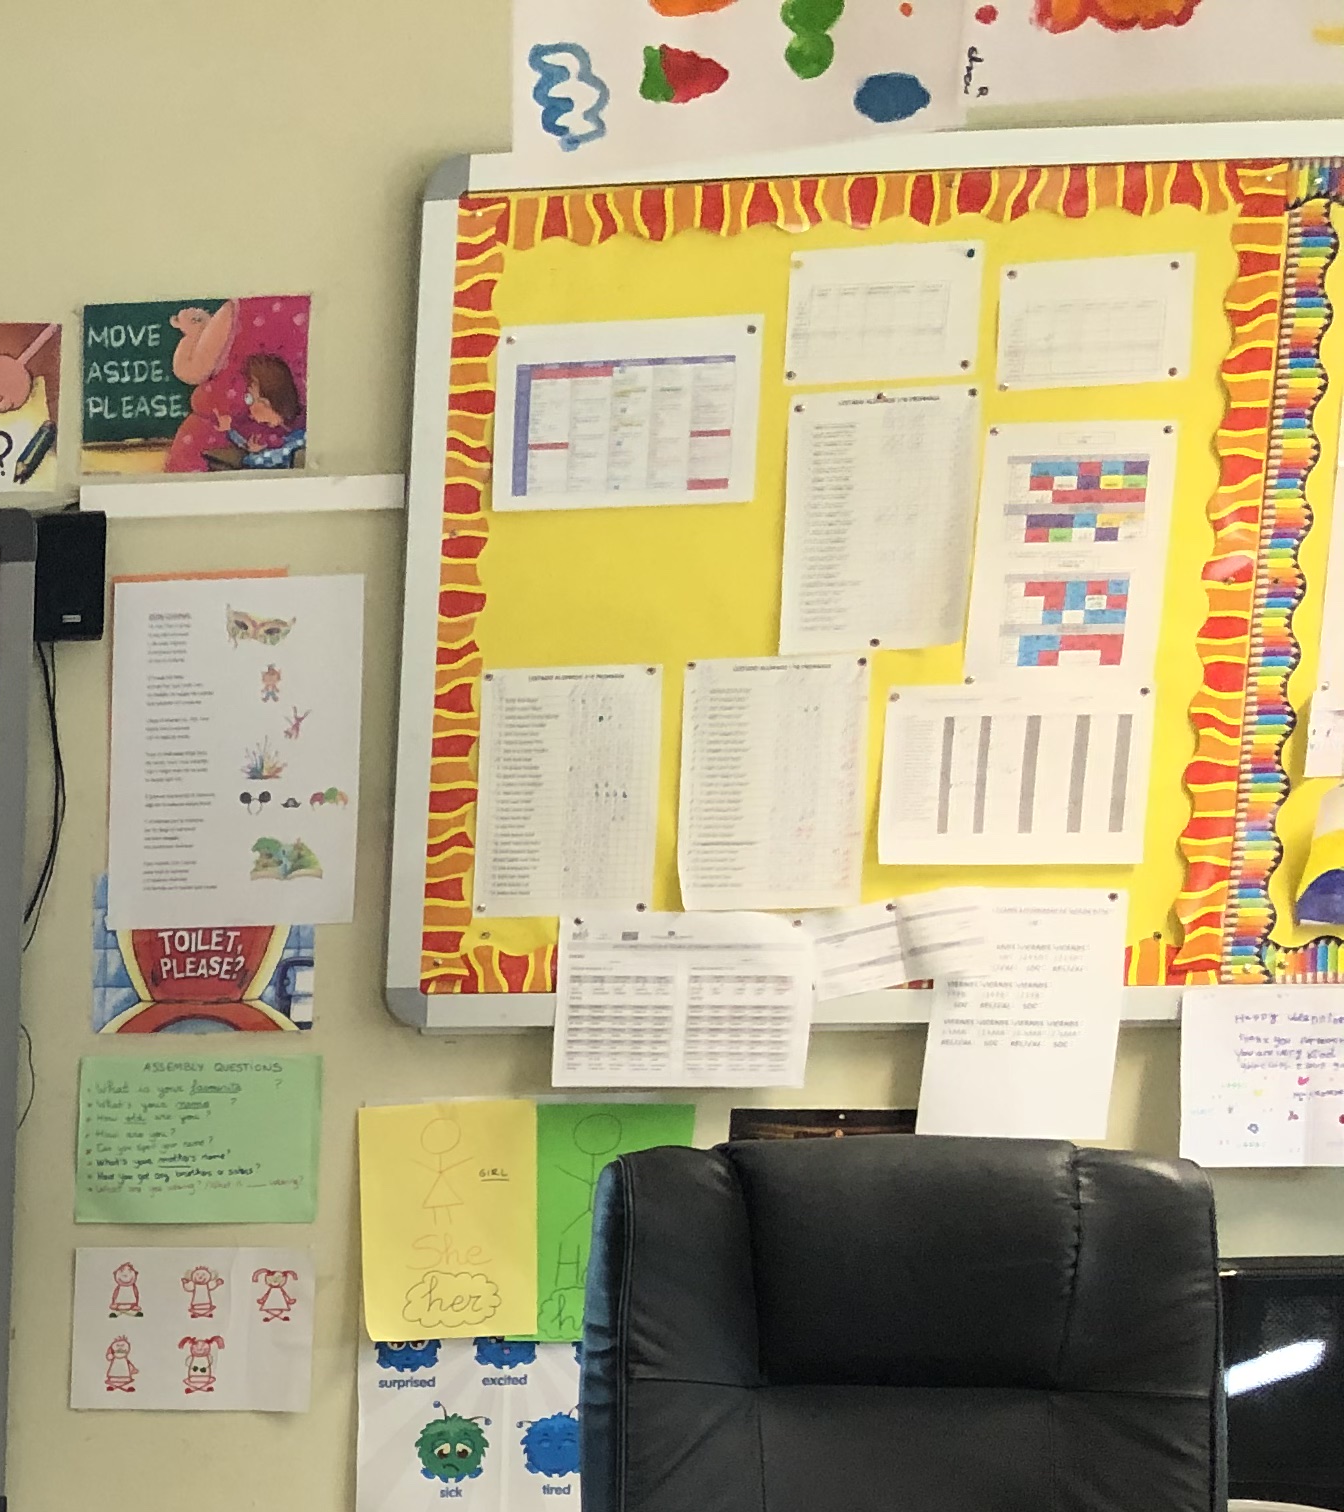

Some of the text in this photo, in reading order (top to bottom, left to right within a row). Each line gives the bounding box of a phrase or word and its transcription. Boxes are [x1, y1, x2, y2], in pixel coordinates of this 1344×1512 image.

[86, 324, 162, 349] MOVE
[158, 929, 244, 954] TOILET,
[160, 955, 245, 981] PLEASE?
[143, 1062, 283, 1073] ASSEMBLY QUESTIONS
[478, 1168, 510, 1179] GIRL
[405, 1233, 493, 1272] She
[419, 1274, 487, 1315] her
[378, 1373, 528, 1391] surprised excited
[439, 1483, 572, 1499] sick tired
